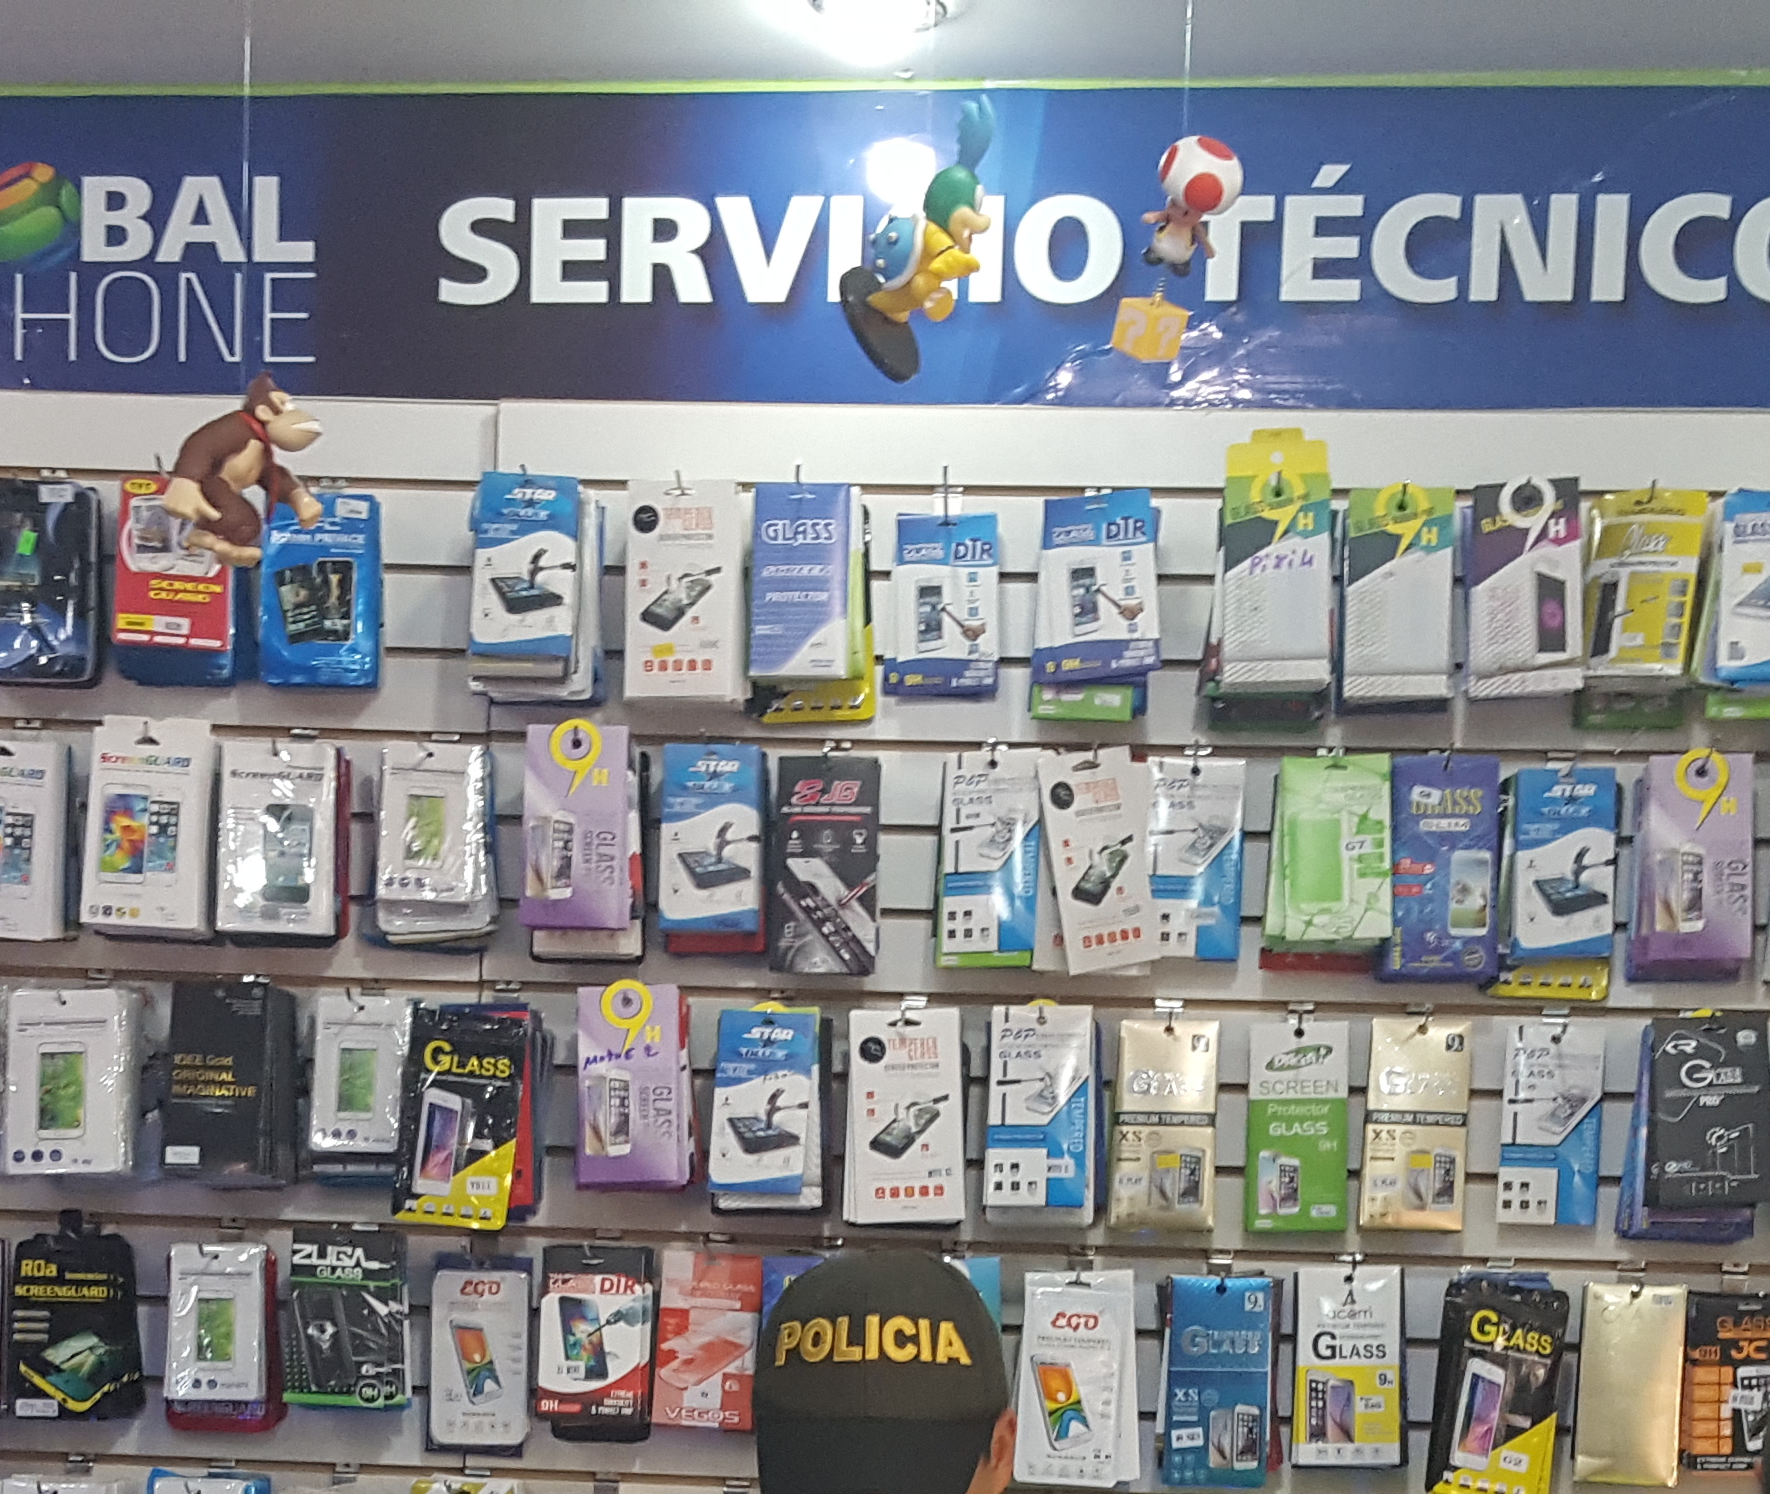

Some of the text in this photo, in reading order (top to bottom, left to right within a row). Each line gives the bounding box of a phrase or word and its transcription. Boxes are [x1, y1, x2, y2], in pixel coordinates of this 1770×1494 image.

[437, 194, 1123, 305] SERVIIO
[761, 519, 836, 546] GLASS
[1104, 515, 1147, 541] DTR
[952, 537, 993, 563] DTR
[423, 1039, 512, 1079] GLASS
[1258, 1079, 1339, 1096] SCREEN
[1268, 1104, 1332, 1119] Protector
[1268, 1122, 1330, 1137] GLASS
[317, 1267, 364, 1280] GLASS
[776, 1313, 972, 1366] POLICIA
[1469, 1308, 1554, 1356] GLASS
[1311, 1331, 1388, 1361] GLASS
[666, 1407, 740, 1425] VEGOS
